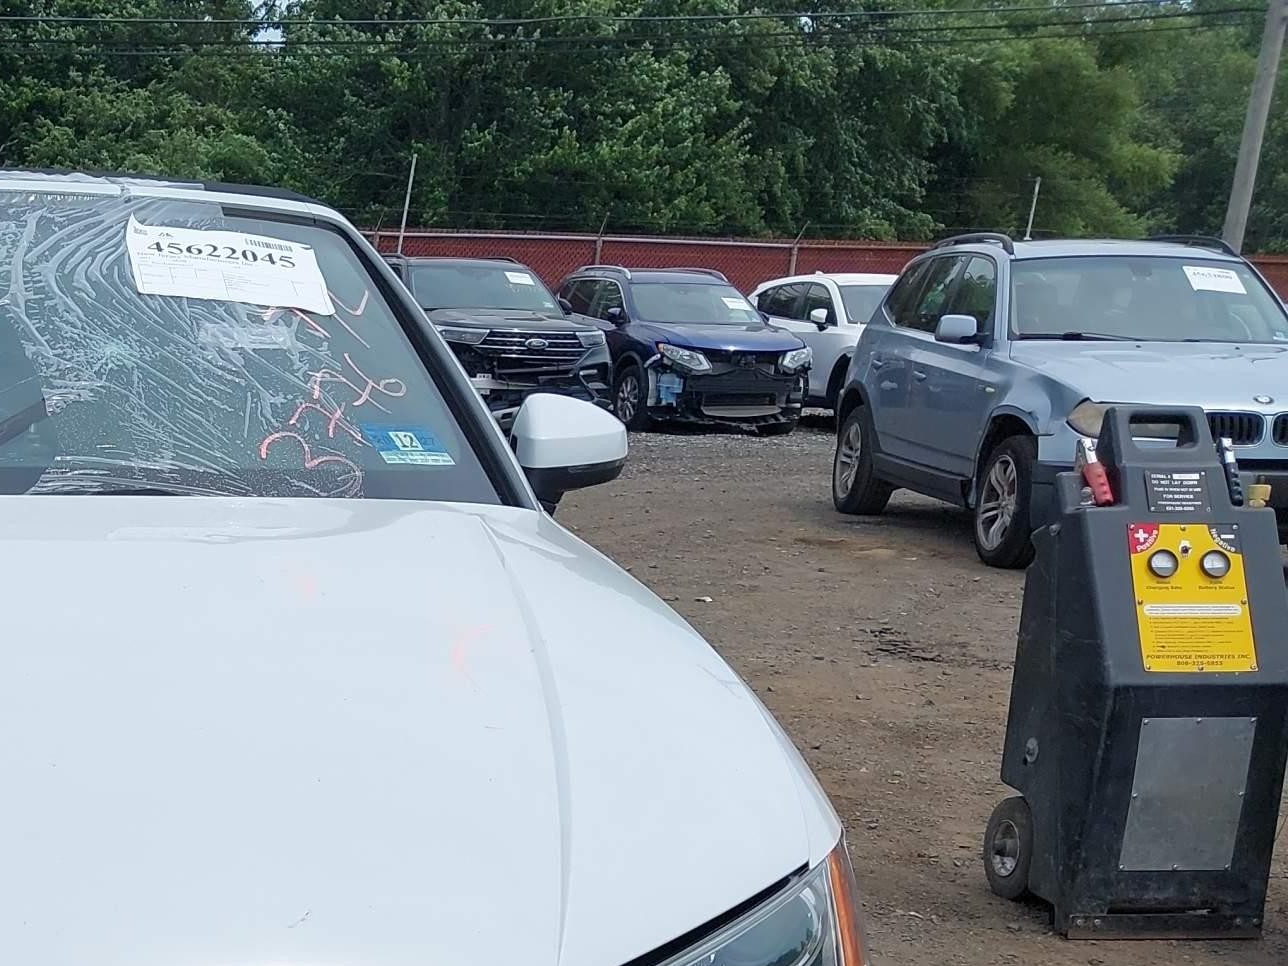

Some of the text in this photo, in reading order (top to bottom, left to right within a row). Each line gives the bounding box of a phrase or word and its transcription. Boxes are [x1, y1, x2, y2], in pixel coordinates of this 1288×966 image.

[147, 241, 296, 269] 45622045
[394, 433, 419, 448] 12
[1136, 529, 1159, 552] Positive
[1210, 528, 1236, 552] Negative
